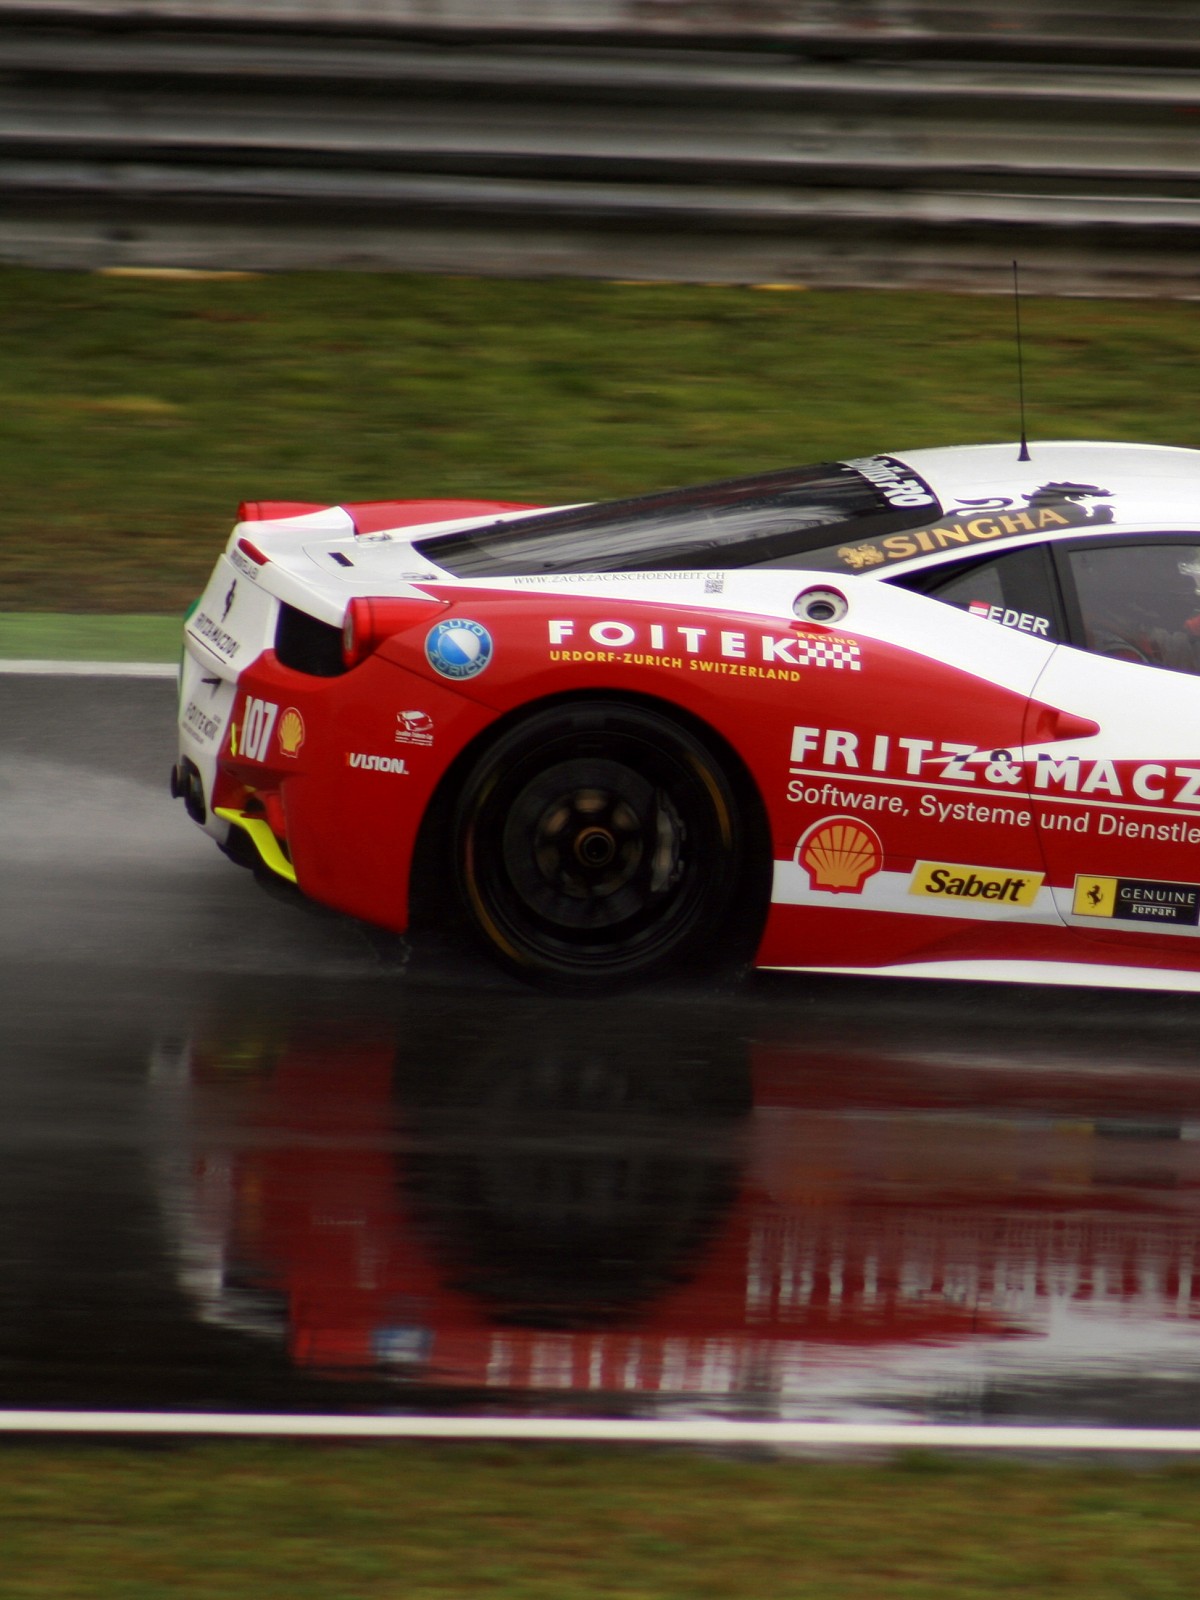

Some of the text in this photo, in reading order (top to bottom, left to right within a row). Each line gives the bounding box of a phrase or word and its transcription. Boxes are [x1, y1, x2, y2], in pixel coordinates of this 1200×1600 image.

[882, 507, 1070, 560] SINGHA
[437, 619, 485, 636] AUTO
[987, 606, 1050, 636] EDER
[547, 619, 802, 665] FOITEK
[797, 631, 858, 647] RACING
[549, 650, 801, 683] URDORF-ZURICH SWITZERLAND
[238, 694, 278, 763] 107
[786, 779, 910, 818] Software,
[918, 794, 1032, 823] Systeme
[1039, 811, 1090, 834] und
[925, 868, 1026, 902] Sabelt
[1120, 886, 1197, 905] GENUINE
[1131, 903, 1177, 918] Ferrari
